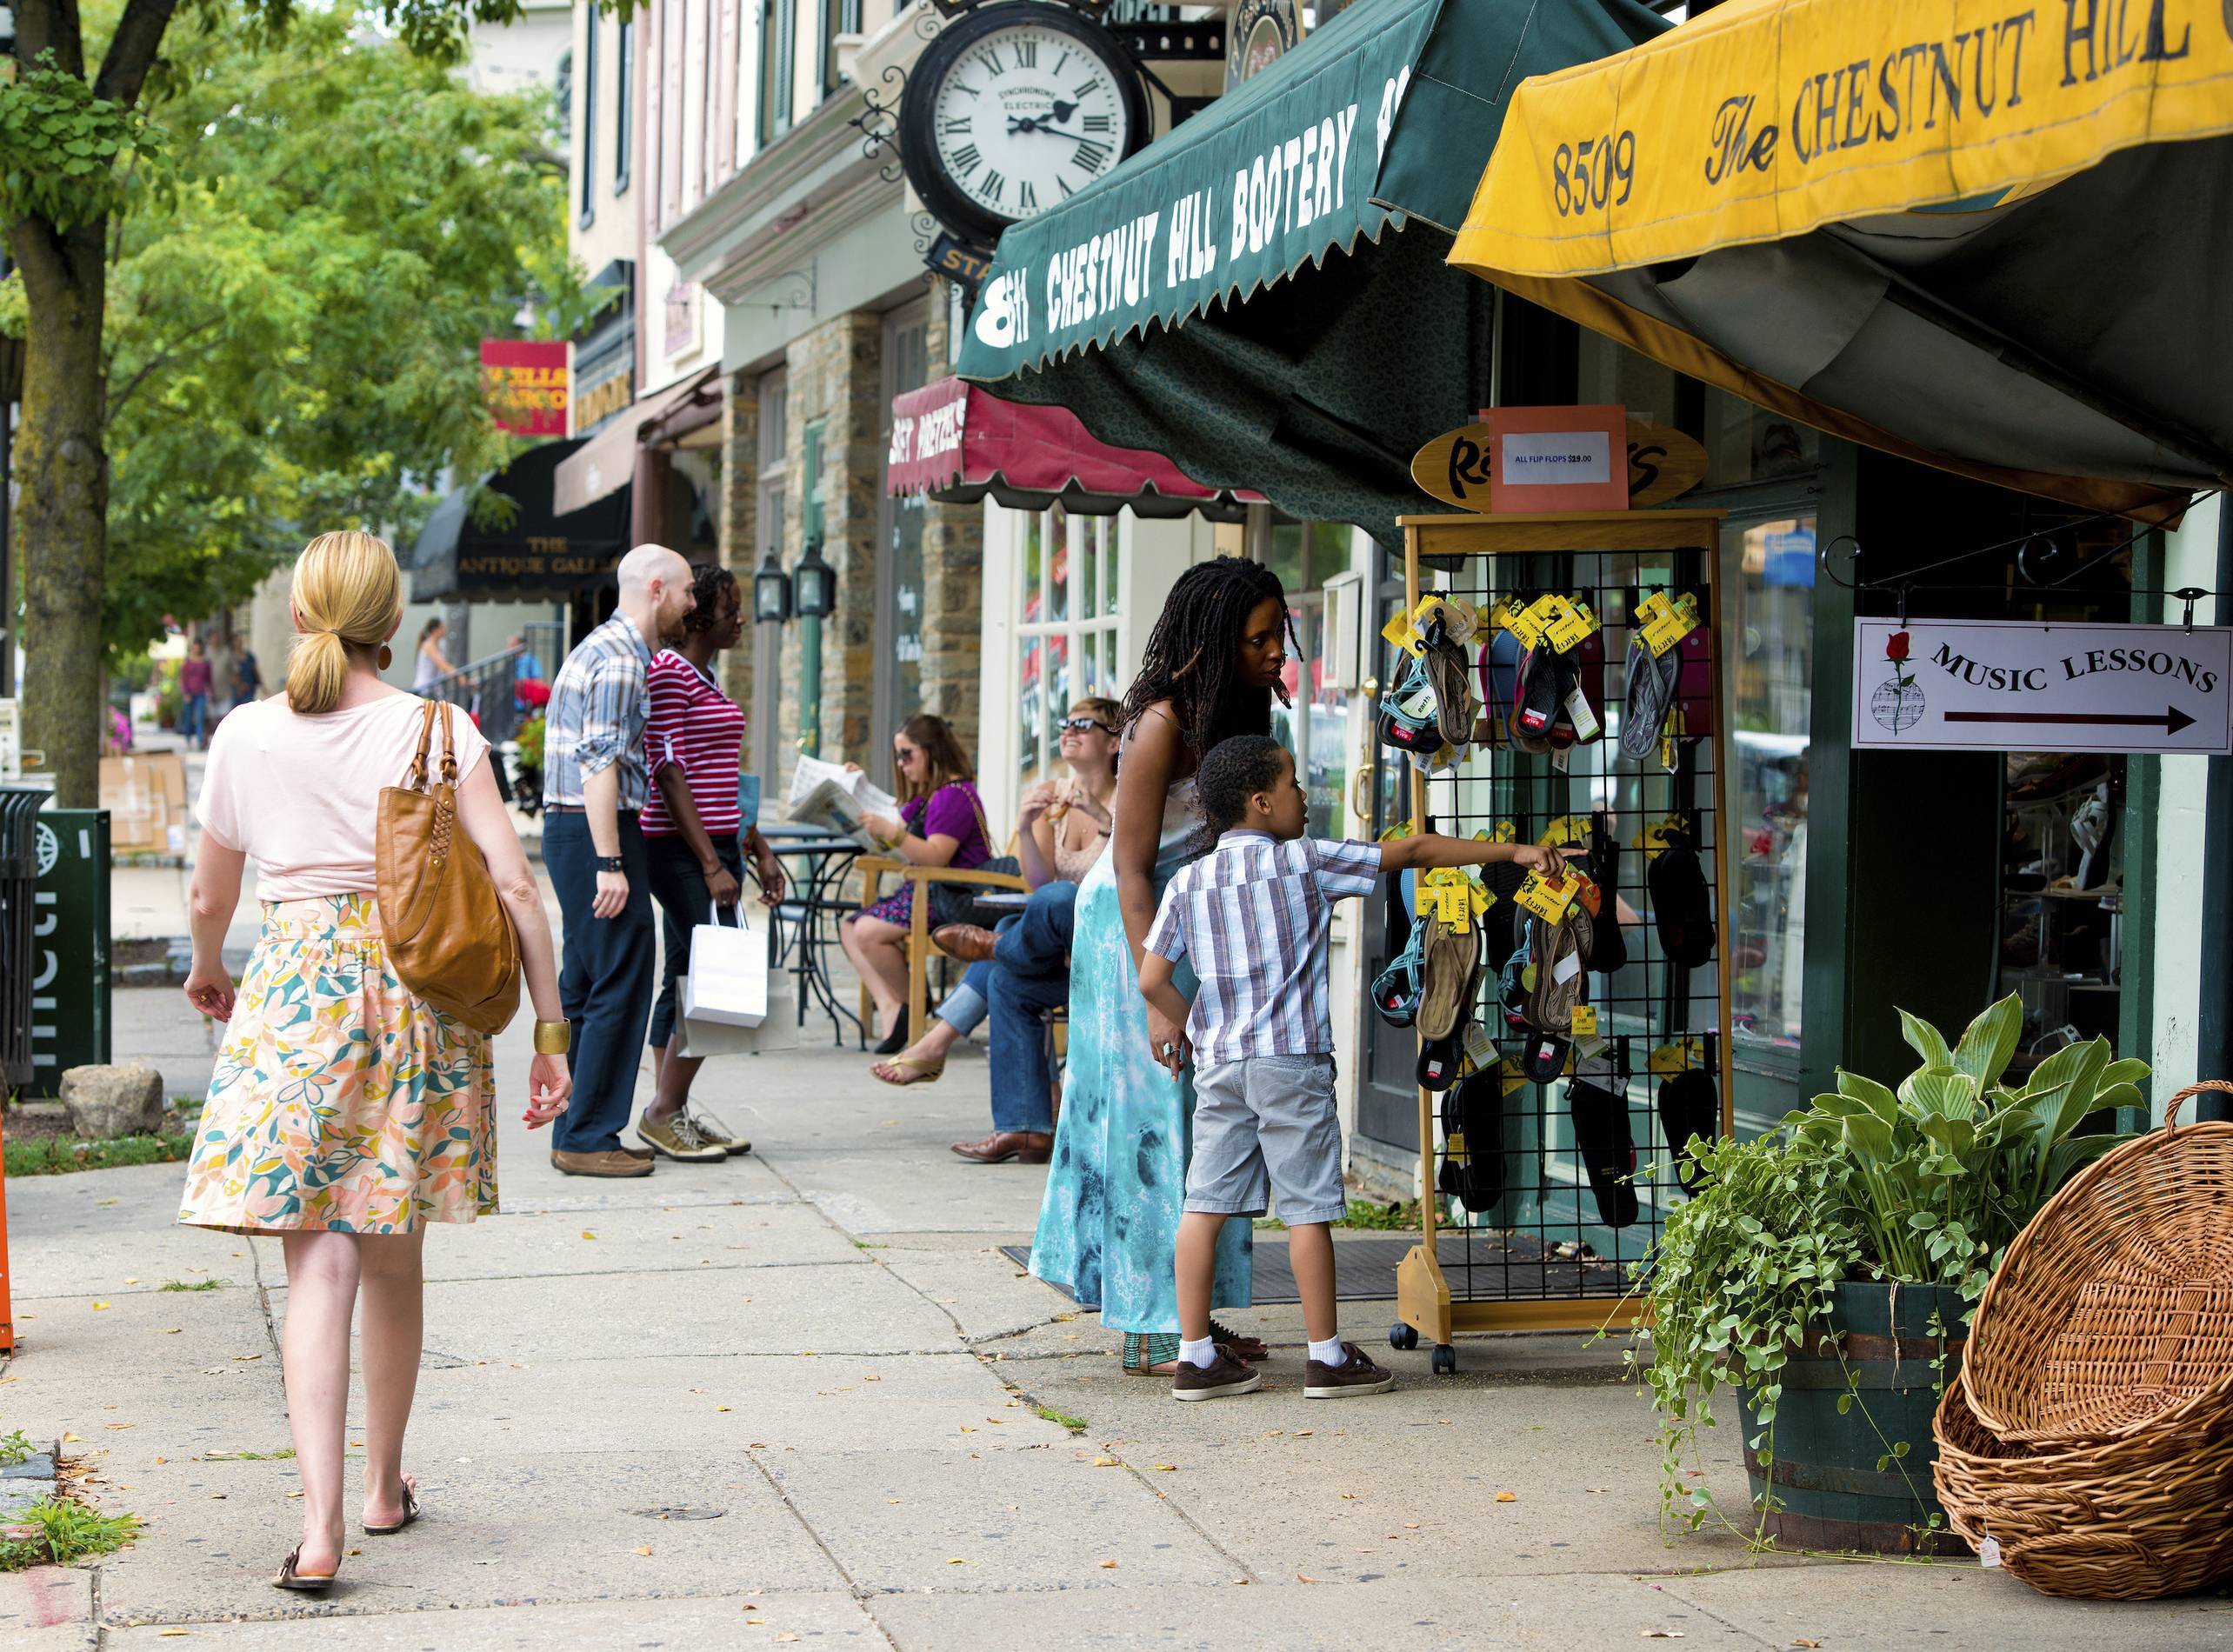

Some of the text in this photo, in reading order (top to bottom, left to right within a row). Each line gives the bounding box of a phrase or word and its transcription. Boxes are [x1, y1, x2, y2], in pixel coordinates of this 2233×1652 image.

[1004, 102, 1053, 110] ELECTRIC
[1553, 130, 1635, 216] 8509
[1705, 96, 1779, 185] The
[1792, 10, 2034, 163] CHESTNUT
[2060, 0, 2190, 88] HILL
[1047, 211, 1159, 334] CHESTNUT
[1167, 187, 1216, 288] HILL
[1230, 103, 1358, 263] BOOTERY
[1568, 454, 1592, 463] $19.00
[527, 536, 568, 553] THE
[1930, 642, 2218, 694] MUSIC LESSONS
[1417, 695, 1432, 714] earth
